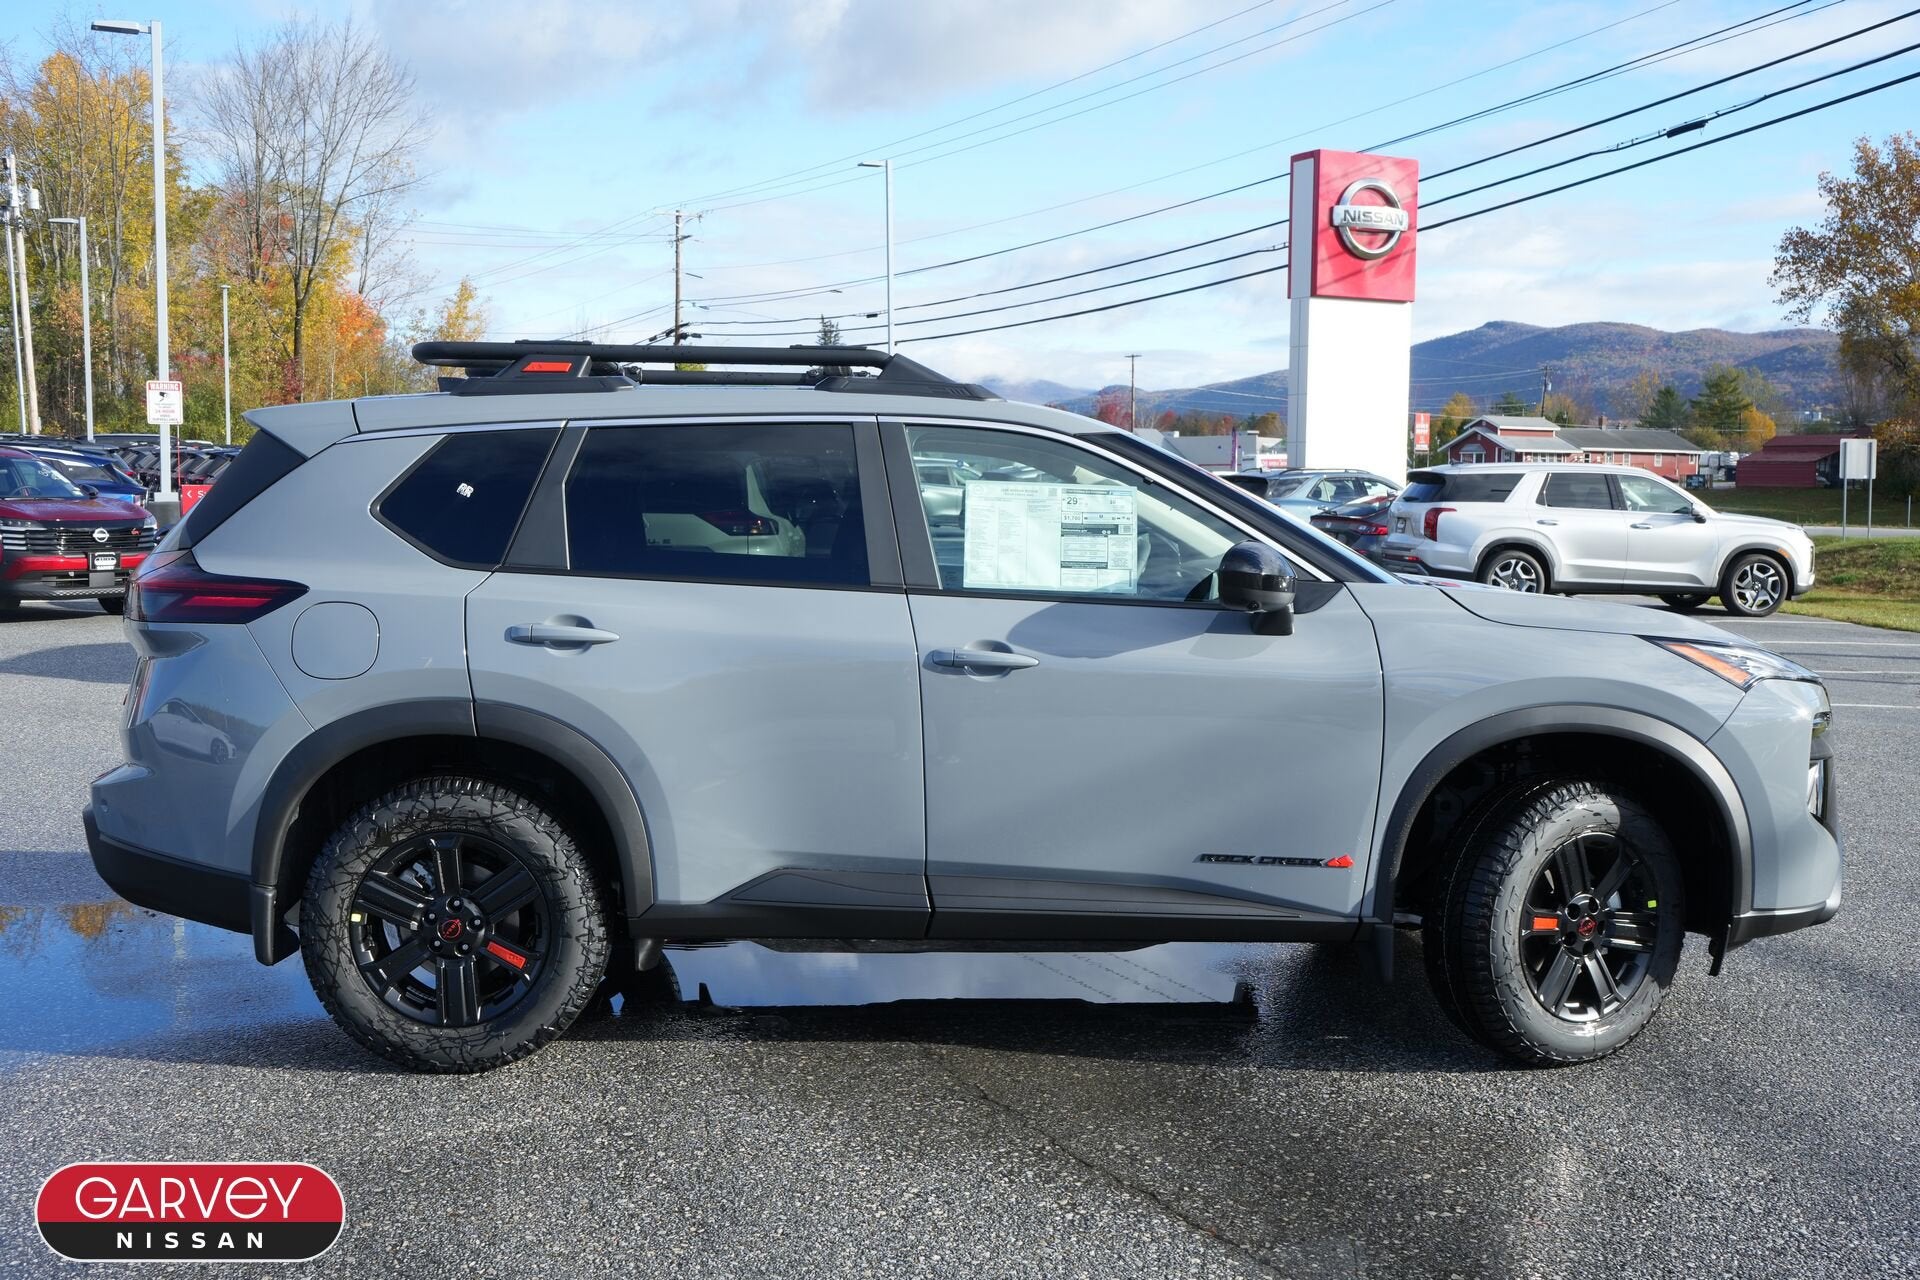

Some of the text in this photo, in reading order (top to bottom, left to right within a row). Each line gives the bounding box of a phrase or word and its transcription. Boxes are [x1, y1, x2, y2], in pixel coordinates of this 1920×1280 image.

[1343, 209, 1404, 226] NISSAN
[150, 382, 179, 391] WARNING
[1066, 496, 1078, 505] 29
[1196, 853, 1327, 867] ROCK CREEK
